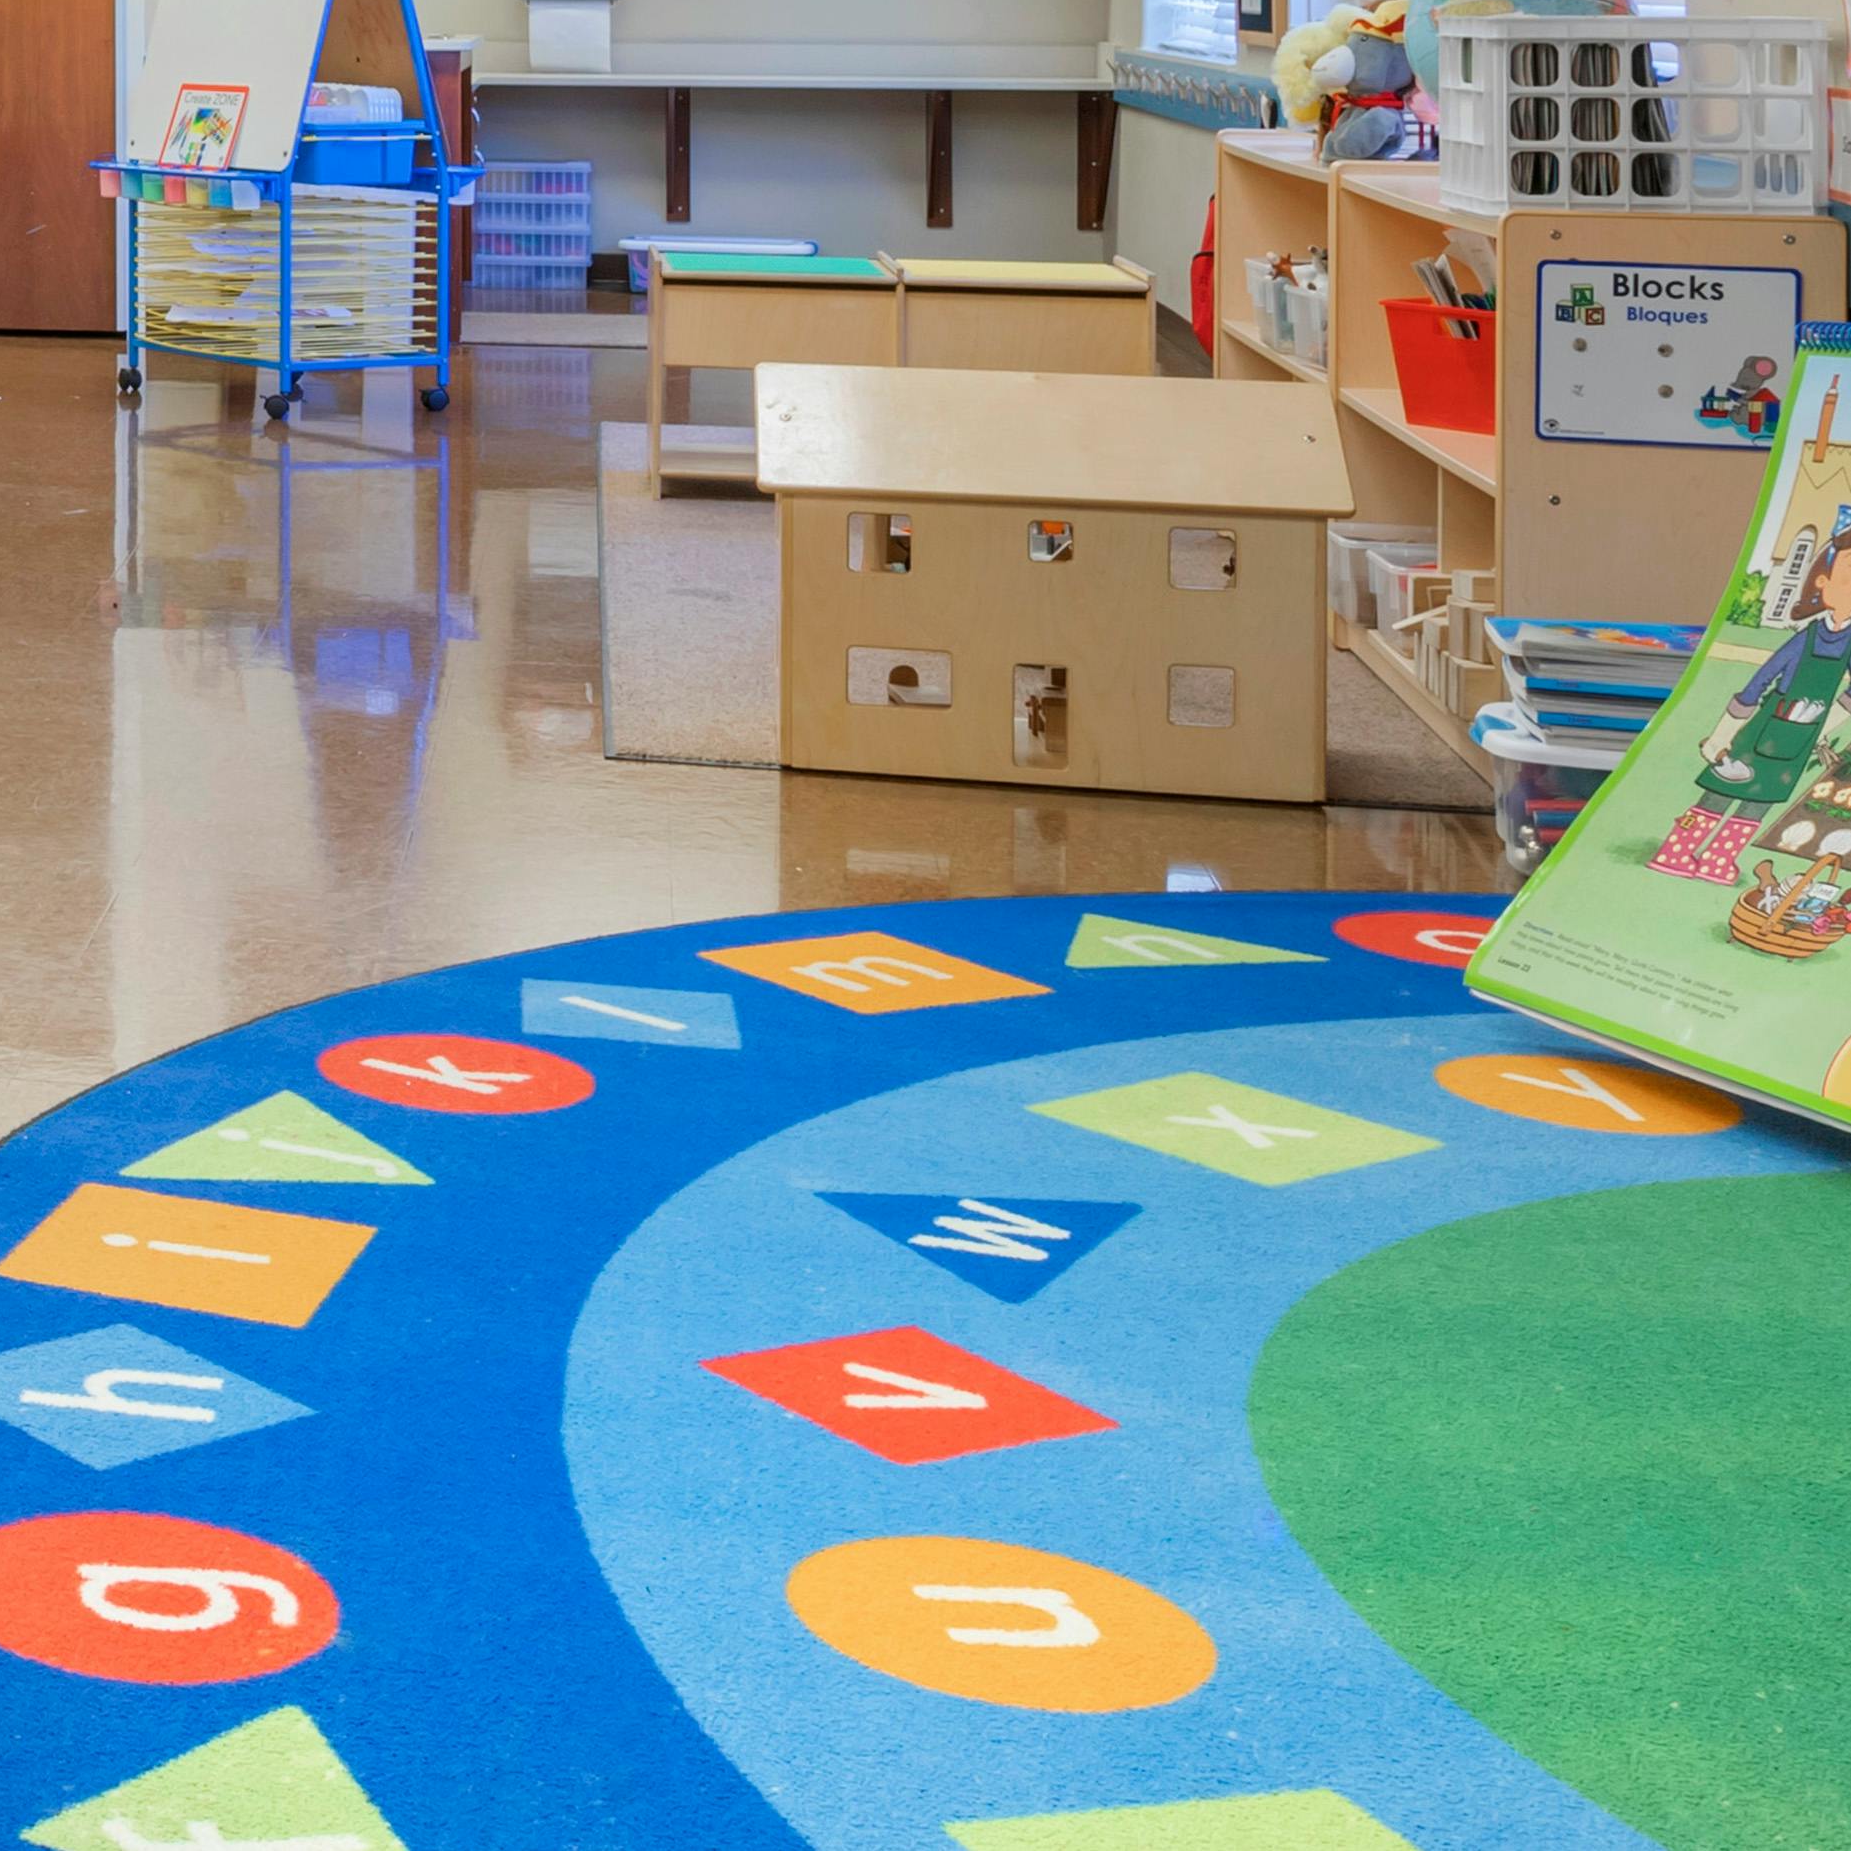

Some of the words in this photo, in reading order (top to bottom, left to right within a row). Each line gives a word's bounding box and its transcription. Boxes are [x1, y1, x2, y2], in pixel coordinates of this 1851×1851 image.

[213, 93, 242, 106] ZONE
[1574, 290, 1591, 306] A
[1612, 272, 1724, 301] Blocks
[1559, 307, 1571, 321] B
[1588, 308, 1602, 323] C
[1627, 306, 1709, 326] Bloques
[1113, 933, 1222, 962] n
[789, 952, 955, 997] m
[360, 1053, 531, 1096] k
[1498, 1066, 1644, 1122] y
[1166, 1104, 1320, 1149] x
[218, 1127, 401, 1180] j
[908, 1197, 1072, 1261] w
[19, 1366, 225, 1424] h
[843, 1361, 988, 1410] v
[78, 1561, 300, 1633] g
[913, 1583, 1101, 1648] u
